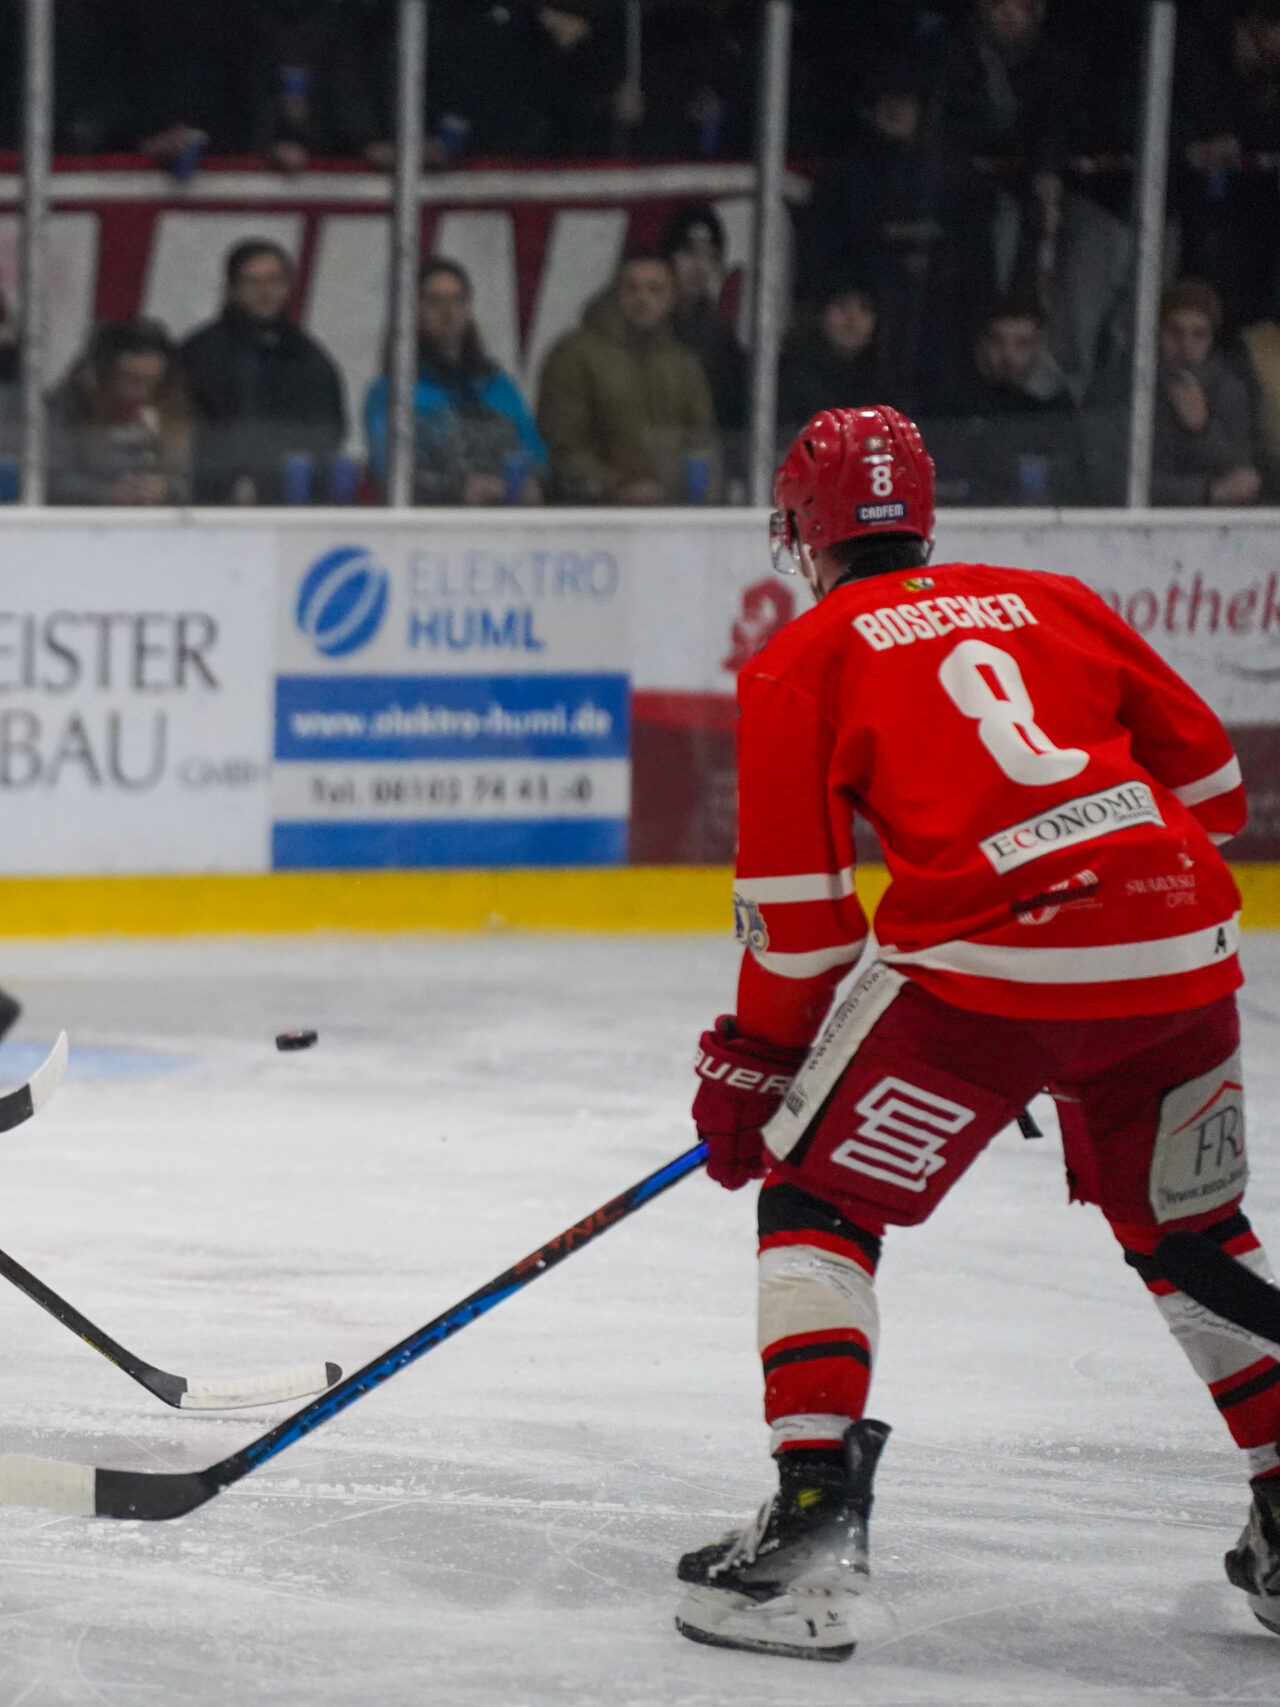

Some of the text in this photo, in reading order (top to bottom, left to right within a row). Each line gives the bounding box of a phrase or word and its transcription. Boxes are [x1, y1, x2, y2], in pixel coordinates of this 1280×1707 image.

[871, 465, 894, 497] 8
[861, 503, 904, 520] CADFEM
[406, 551, 619, 597] ELEKTRO
[407, 607, 546, 650] HUML
[852, 592, 1038, 651] BOSECKER
[938, 639, 1090, 787] 8
